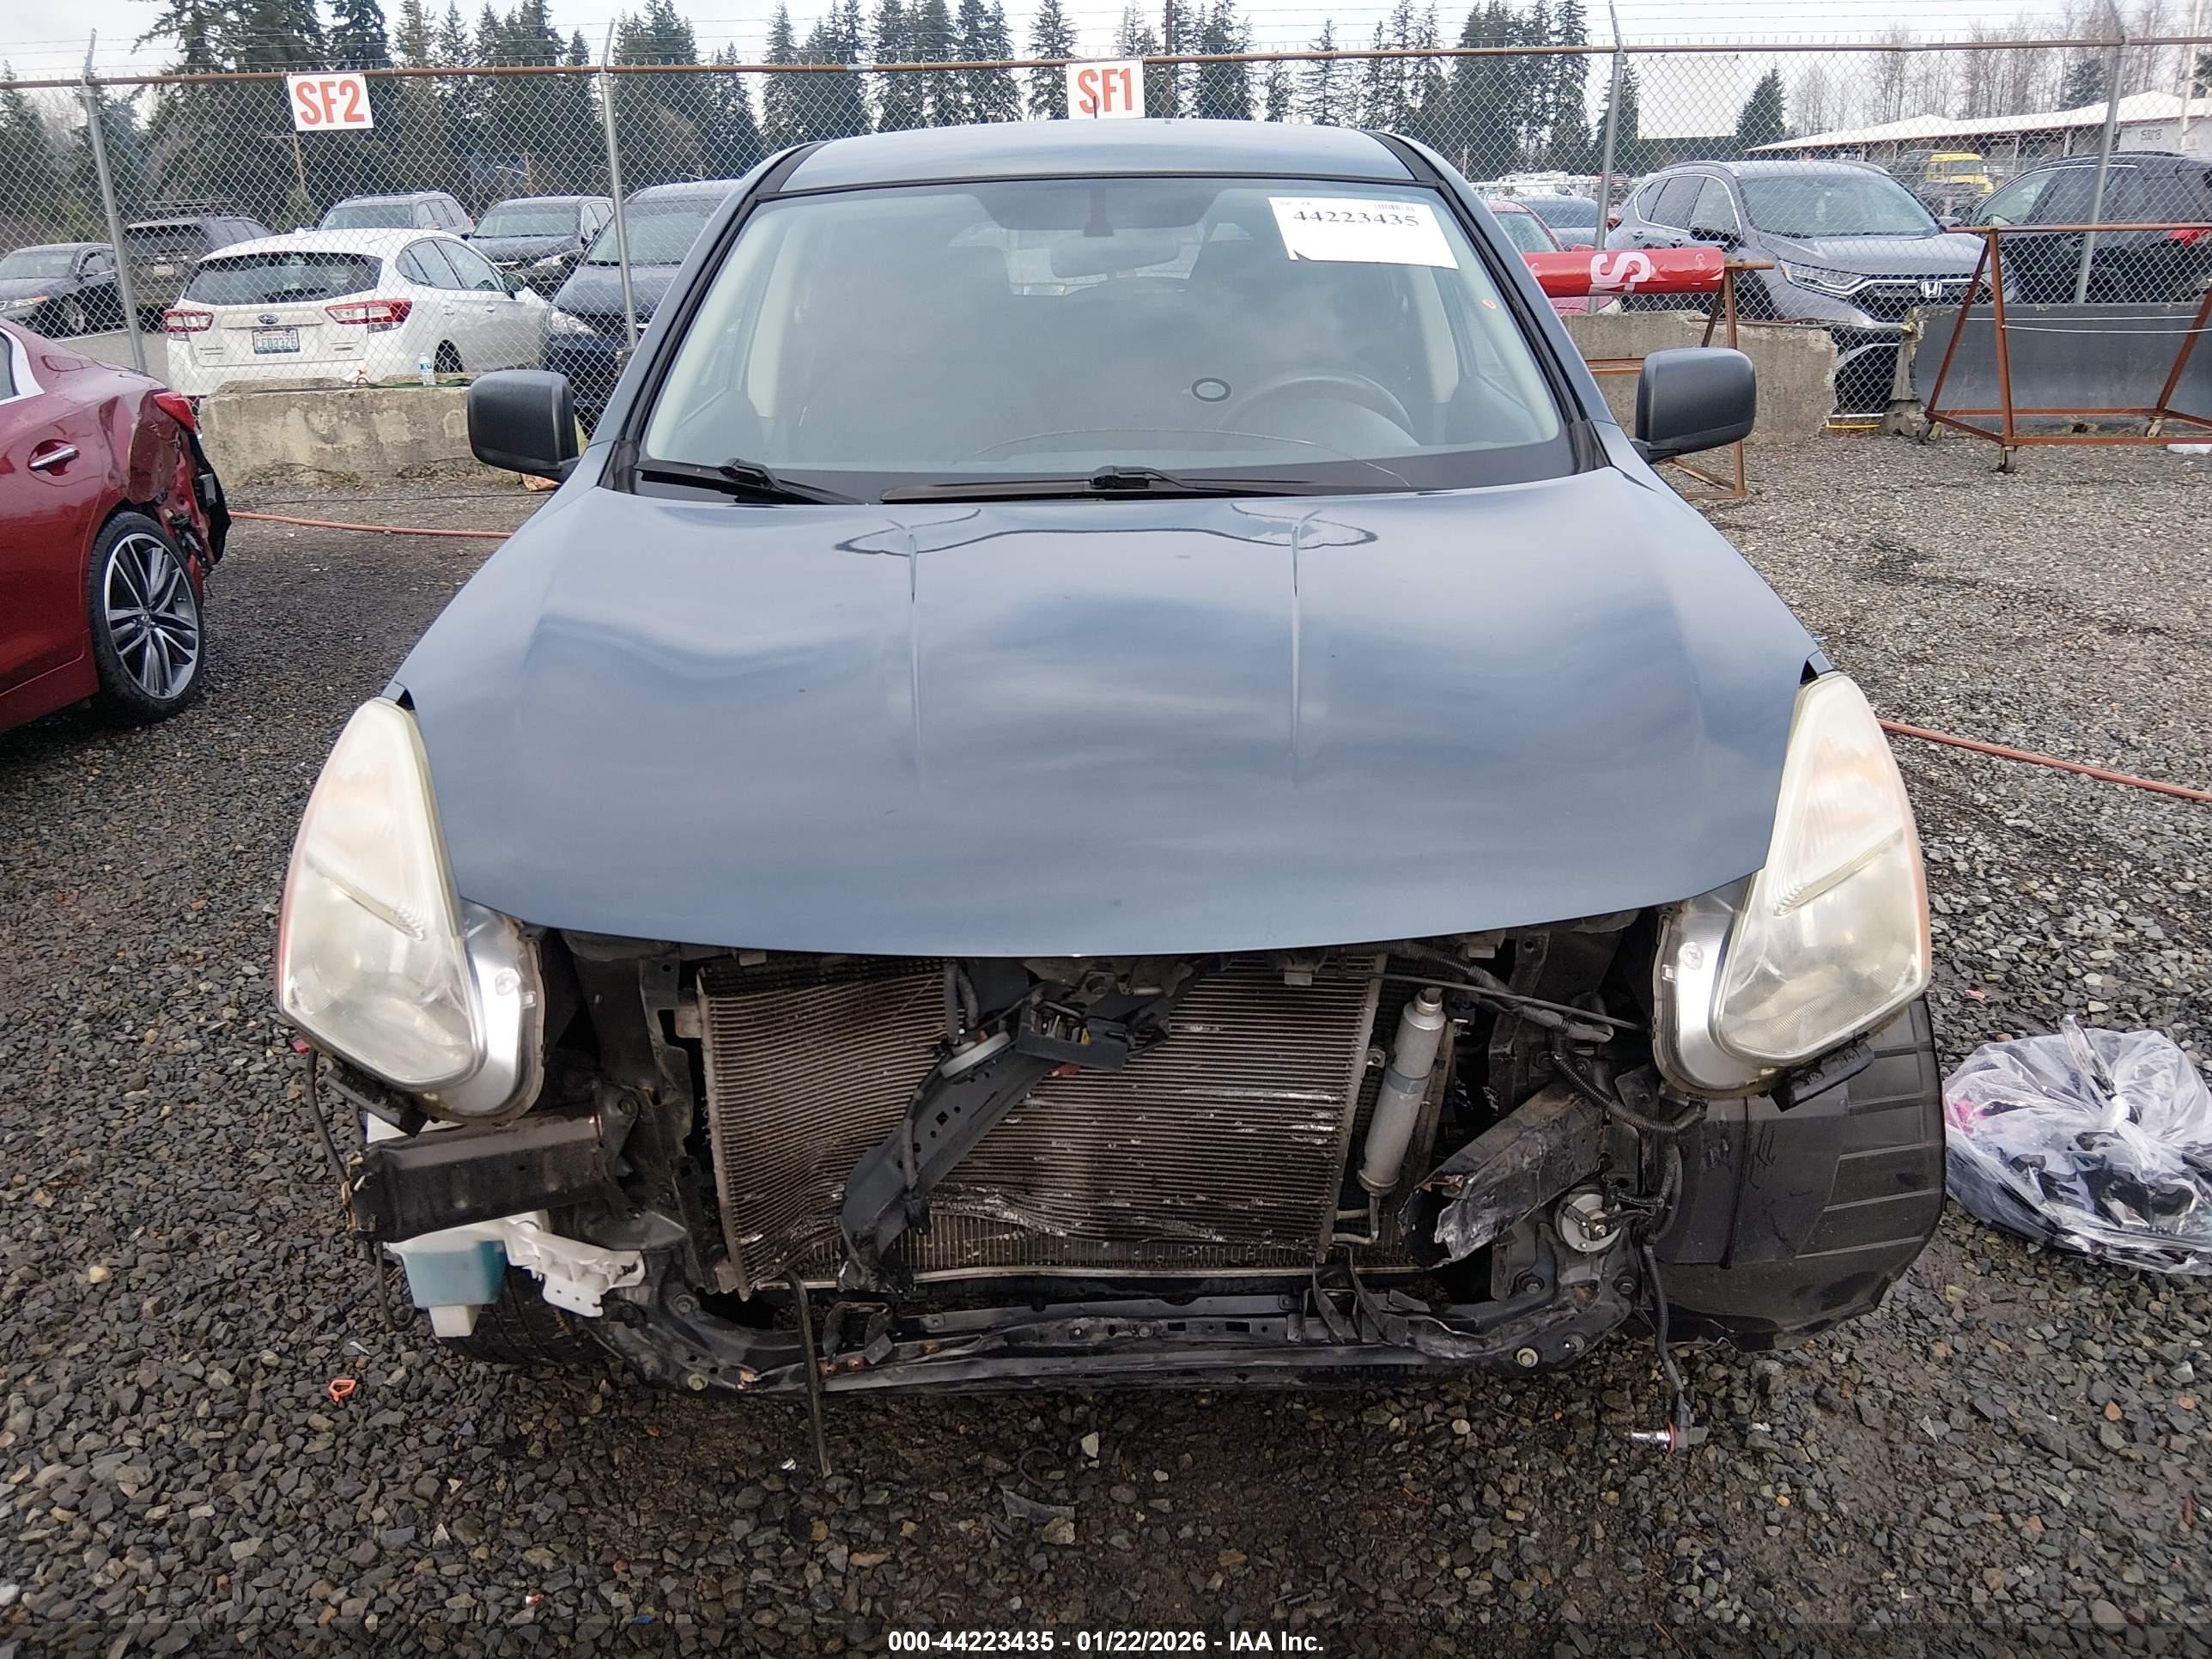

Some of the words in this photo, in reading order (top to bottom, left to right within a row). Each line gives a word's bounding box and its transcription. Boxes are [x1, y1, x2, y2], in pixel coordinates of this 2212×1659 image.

[295, 79, 366, 125] SF2
[1078, 68, 1133, 114] SF1
[1293, 210, 1419, 227] 44223435
